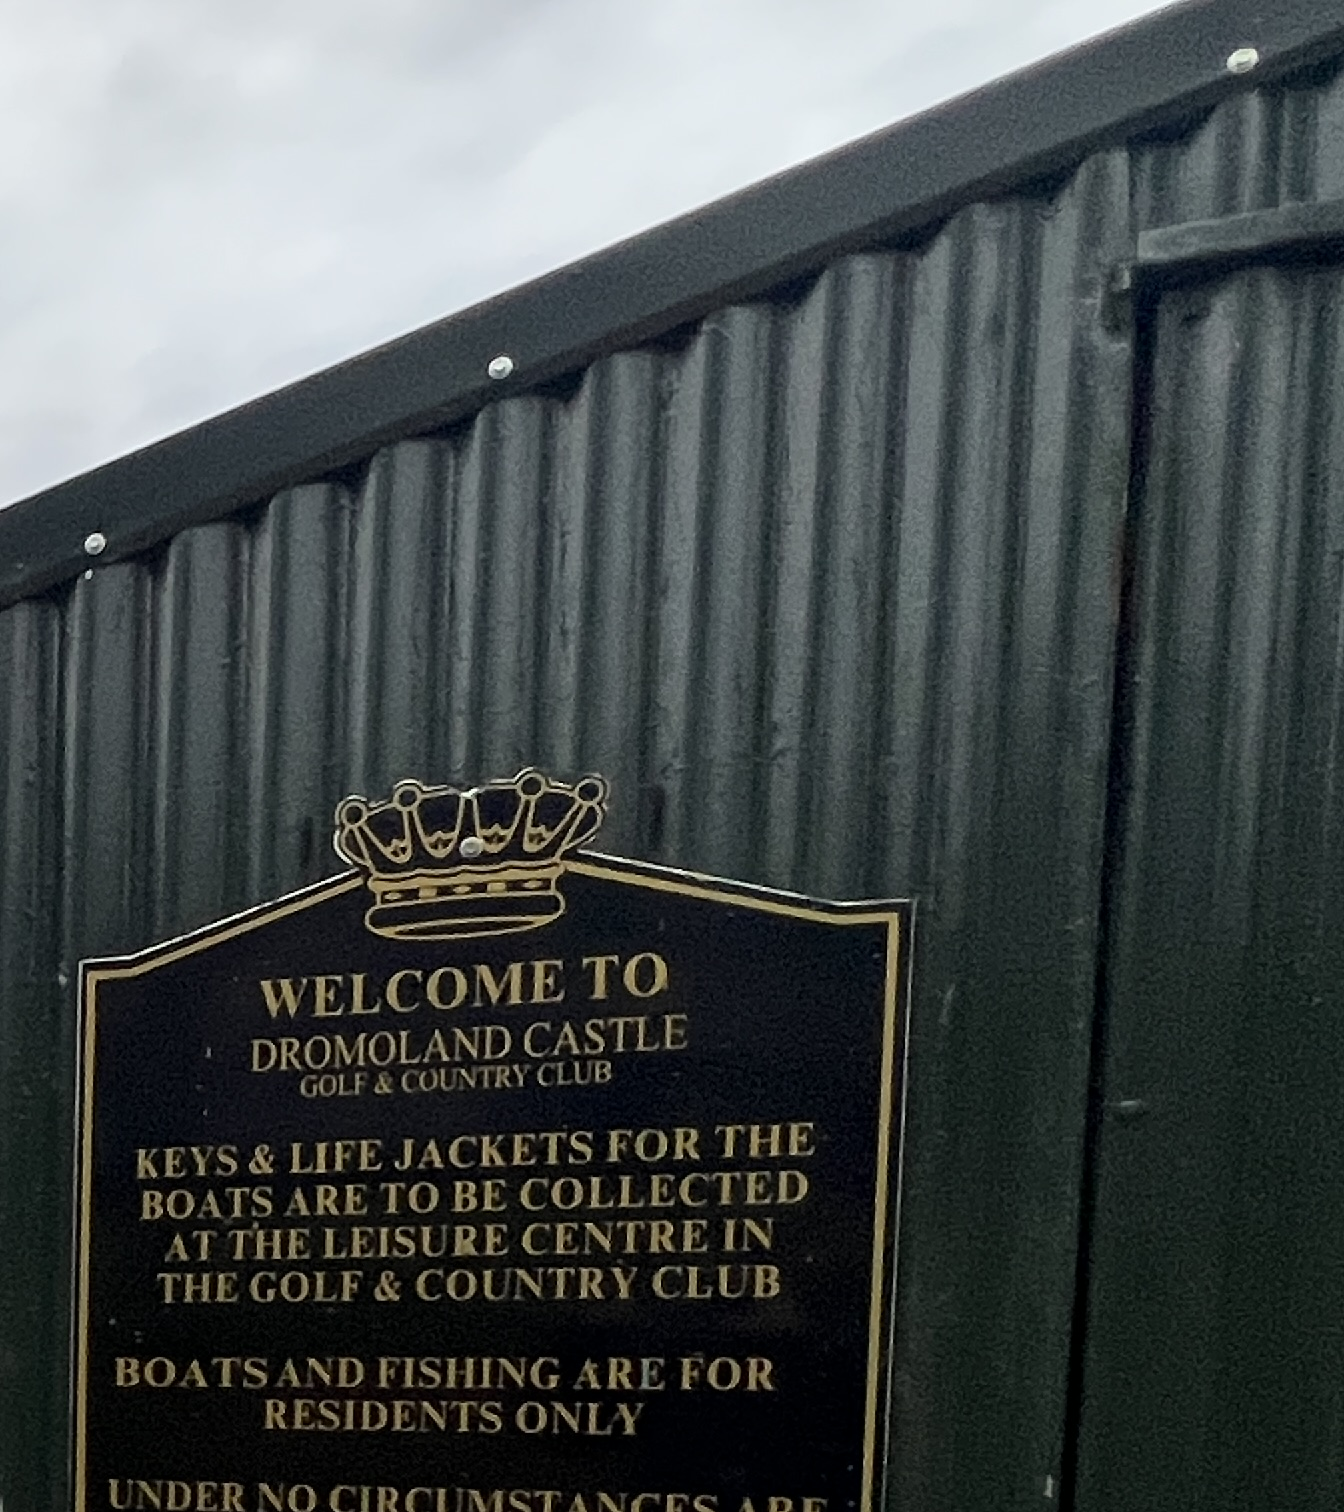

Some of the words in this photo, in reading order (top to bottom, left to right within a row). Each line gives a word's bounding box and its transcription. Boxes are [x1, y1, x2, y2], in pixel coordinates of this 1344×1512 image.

[259, 960, 565, 1017] WELCOME
[582, 952, 669, 998] TO
[250, 1025, 512, 1071] DROMOLAND
[522, 1015, 689, 1056] CASTLE
[300, 1071, 368, 1098] GOLF
[374, 1071, 394, 1094] &
[401, 1063, 531, 1093] COUNTRY
[537, 1061, 612, 1086] CLUB
[136, 1145, 238, 1180] KEYS
[249, 1144, 274, 1174] &
[289, 1139, 383, 1172] LIFE
[394, 1132, 594, 1171] JACKETS
[608, 1128, 700, 1163] FOR
[714, 1123, 816, 1160] THE
[141, 1187, 274, 1221] BOATS
[285, 1184, 367, 1217] ARE
[380, 1181, 441, 1214] TO
[453, 1179, 507, 1212] BE
[520, 1170, 809, 1210] COLLECTED
[165, 1230, 216, 1260] AT
[226, 1228, 310, 1259] THE
[323, 1224, 508, 1258] LEISURE
[521, 1220, 707, 1255] CENTRE
[721, 1218, 774, 1251] IN
[157, 1273, 238, 1304] THE
[250, 1271, 364, 1304] GOLF
[374, 1271, 402, 1302] &
[415, 1266, 639, 1302] COUNTRY
[652, 1264, 781, 1299] CLUB
[115, 1358, 269, 1389] BOATS
[276, 1358, 365, 1389] AND
[377, 1358, 560, 1391] FISHING
[573, 1358, 667, 1391] ARE
[679, 1357, 776, 1392] FOR
[263, 1401, 503, 1434] RESIDENTS
[515, 1401, 645, 1436] ONLY
